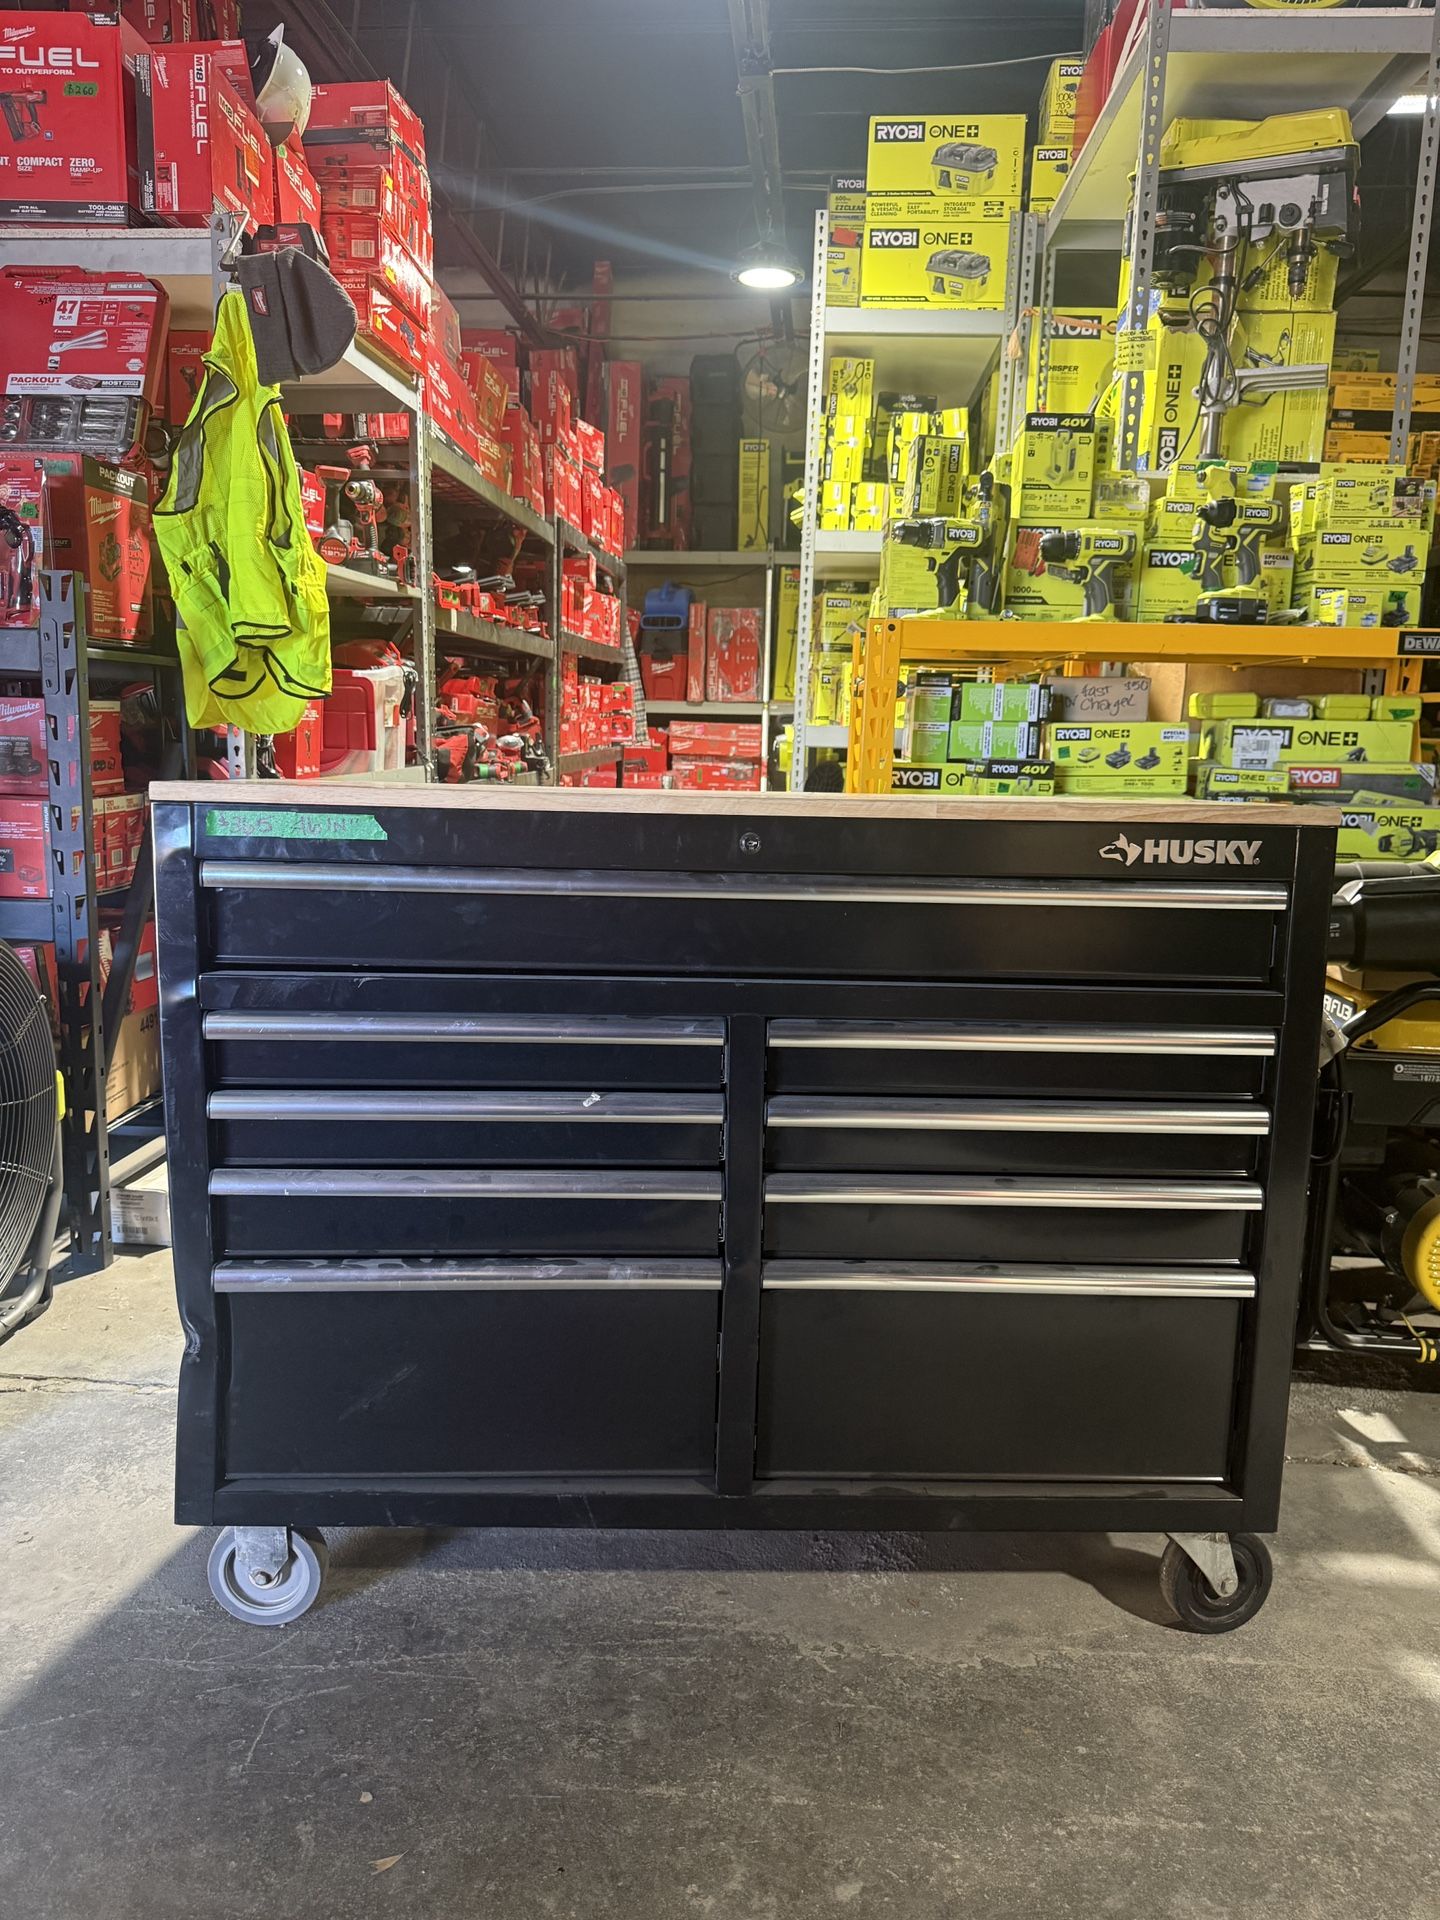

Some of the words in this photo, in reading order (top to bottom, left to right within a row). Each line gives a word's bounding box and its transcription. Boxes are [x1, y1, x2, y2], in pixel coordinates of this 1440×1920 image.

[15, 68, 76, 76] OUTPERFORM.
[195, 55, 205, 82] M18
[67, 83, 94, 95] $260
[196, 85, 209, 155] FUEL
[876, 125, 924, 140] RYOBI
[233, 112, 265, 164] FUEL
[1038, 150, 1066, 159] RYOBI
[16, 157, 64, 167] COMPACT
[69, 158, 95, 167] ZERO
[837, 179, 865, 189] RYOBI
[871, 231, 917, 246] RYOBI
[56, 300, 79, 315] 47
[474, 347, 509, 356] FUEL
[10, 376, 63, 384] PACKOUT
[618, 398, 629, 444] FUEL
[1031, 417, 1058, 427] RYOBI
[1060, 417, 1090, 427] 40V
[1160, 430, 1177, 471] YOBI
[950, 444, 959, 473] RYOBI
[99, 466, 135, 487] PACKOUT
[88, 496, 122, 518] Milwaukee
[1167, 503, 1193, 512] RYOBI
[1246, 508, 1269, 517] RYOBI
[948, 530, 976, 540] RYOBI
[1323, 534, 1351, 543] RYOBI
[1095, 539, 1119, 548] RYOBI
[1013, 586, 1031, 594] 1000
[827, 598, 850, 608] RYOBI
[1056, 730, 1090, 740] RYOBI
[992, 765, 1018, 773] RYOBI
[1021, 765, 1050, 774] 40V
[892, 770, 938, 787] RYOBI
[1215, 774, 1238, 782] RYOBI
[1290, 769, 1337, 784] RYOBI
[1143, 839, 1263, 865] HUSKY
